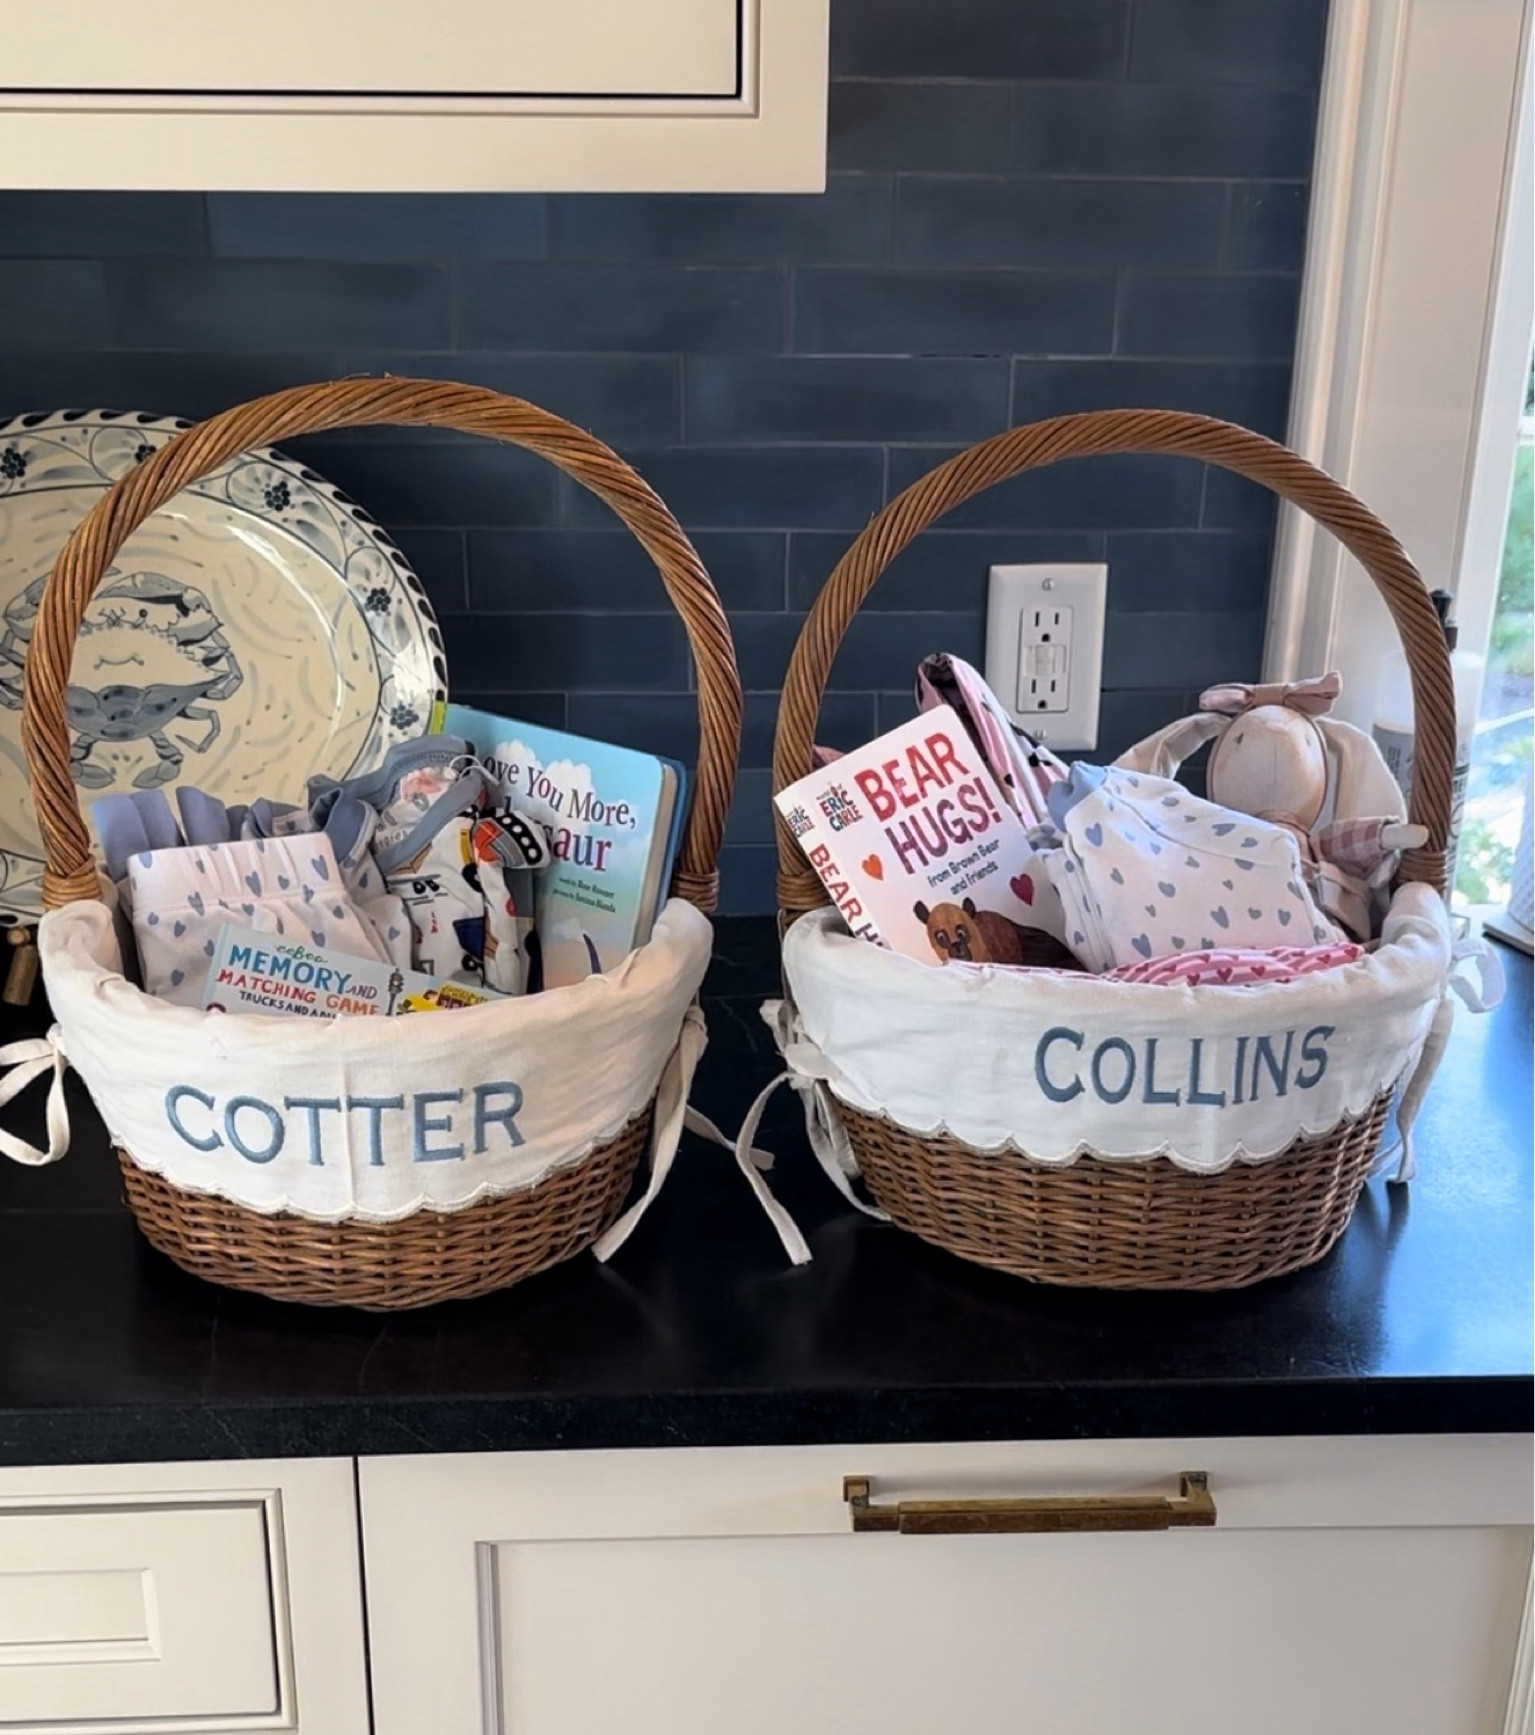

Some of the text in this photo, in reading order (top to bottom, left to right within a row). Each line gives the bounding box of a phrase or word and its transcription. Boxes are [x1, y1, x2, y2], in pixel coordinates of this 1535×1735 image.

[526, 766, 564, 812] You
[567, 788, 637, 830] More,
[820, 789, 853, 817] ERIC
[854, 732, 970, 823] BEAR
[829, 804, 863, 831] CARLE
[884, 777, 1002, 875] HUGS!
[809, 843, 863, 923] BEAR
[927, 839, 999, 888] from Brown Bear
[950, 877, 968, 895] and
[215, 969, 380, 1016] MATCHING GAME
[228, 944, 352, 995] MEMORY
[239, 990, 285, 1009] TRUCKS
[1035, 1025, 1336, 1108] COLLINS
[165, 1080, 525, 1166] COTTER
